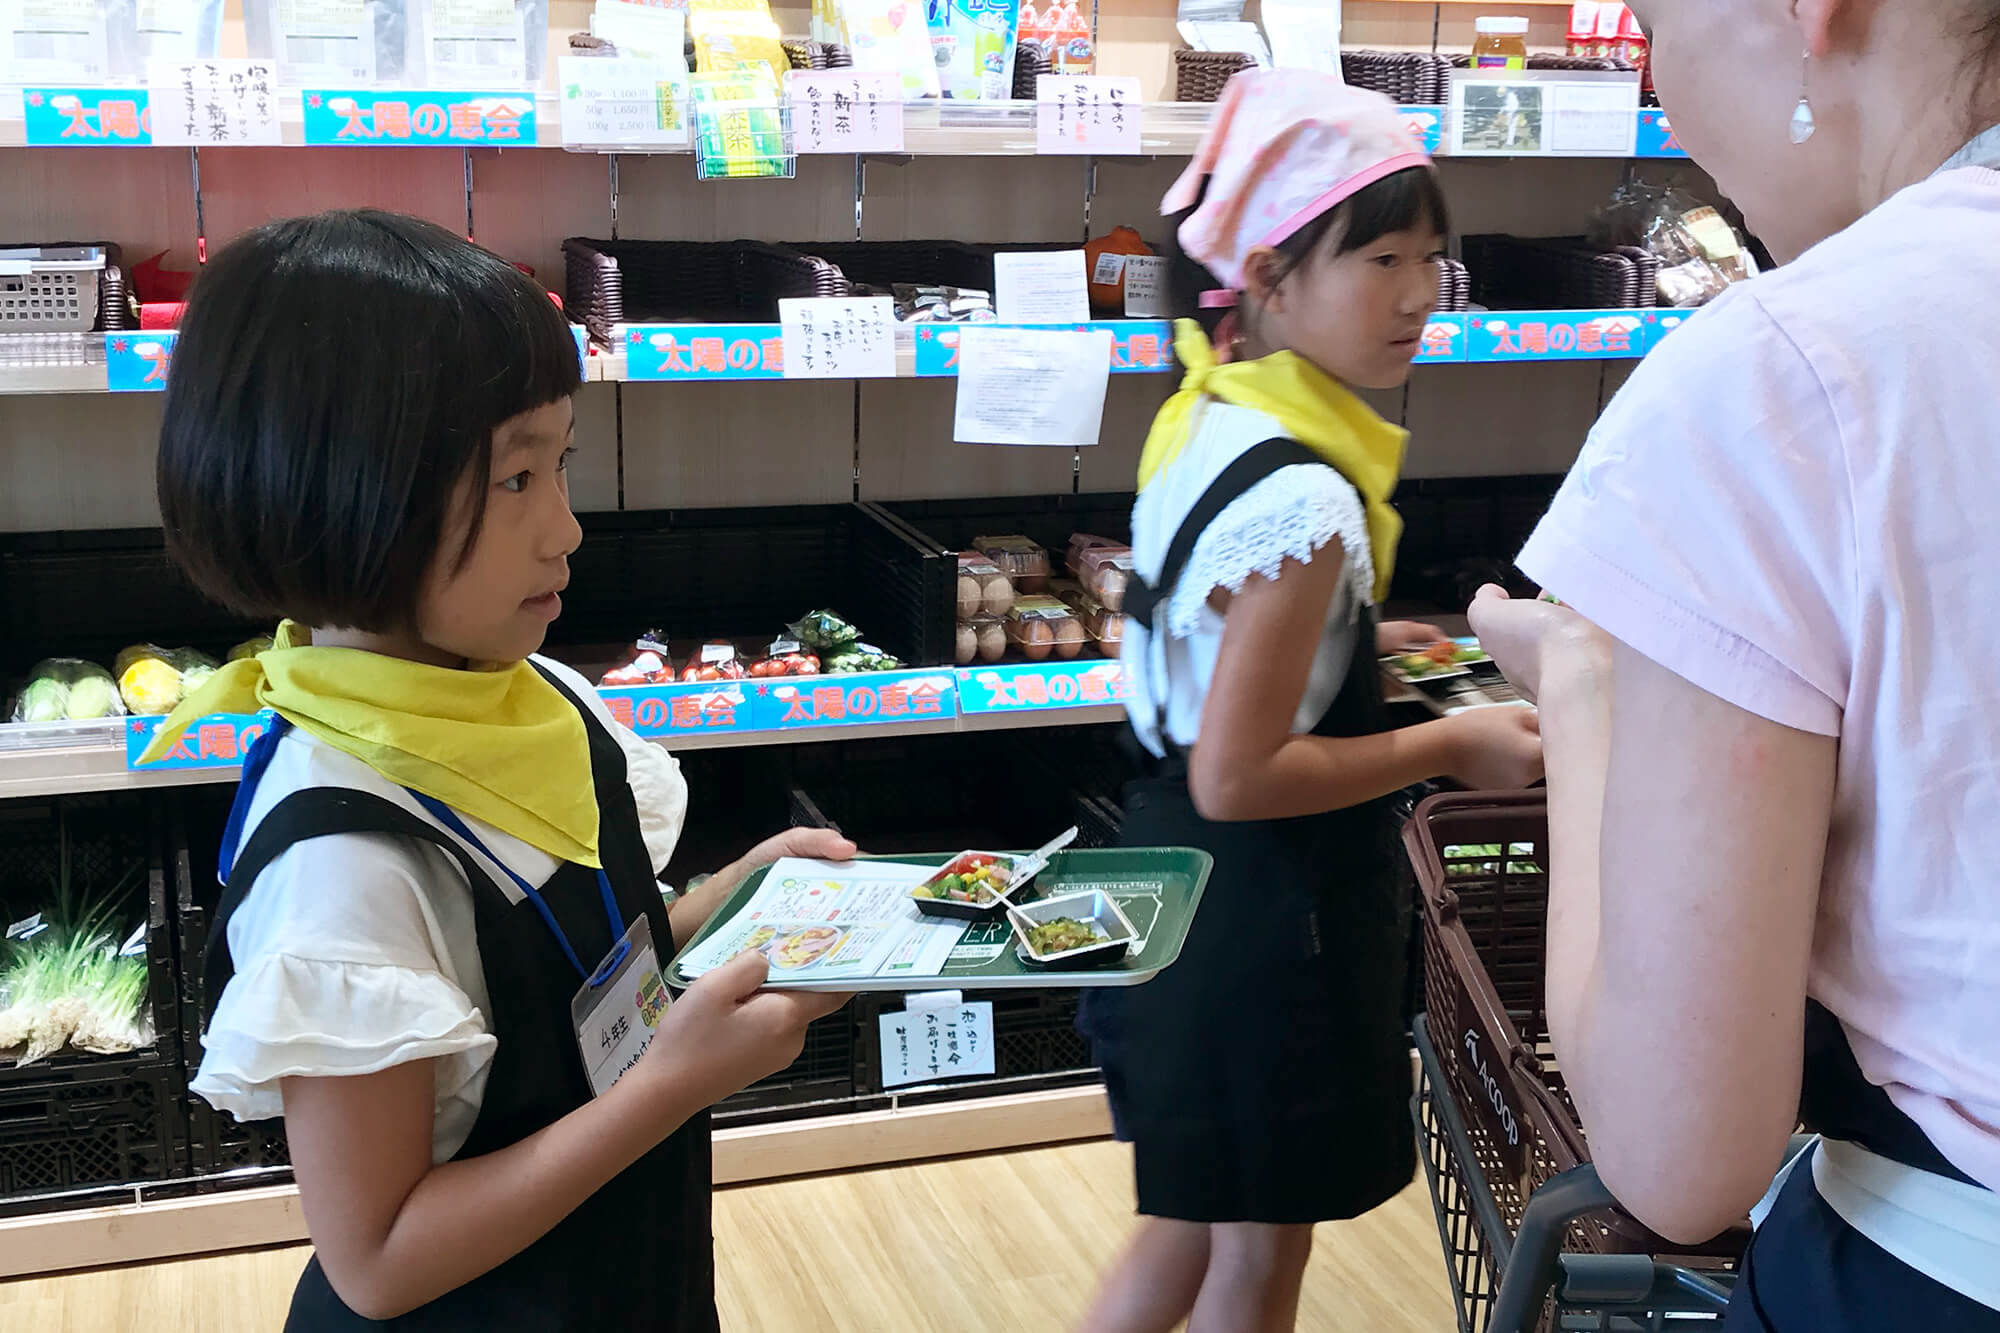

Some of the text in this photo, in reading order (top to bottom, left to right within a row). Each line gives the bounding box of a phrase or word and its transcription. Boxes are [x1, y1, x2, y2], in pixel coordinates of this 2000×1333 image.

[335, 102, 521, 139] 太陽の恵会
[1492, 322, 1631, 355] 太陽の恵会
[782, 683, 943, 721] 太陽の恵会
[601, 1015, 631, 1049] 4年生
